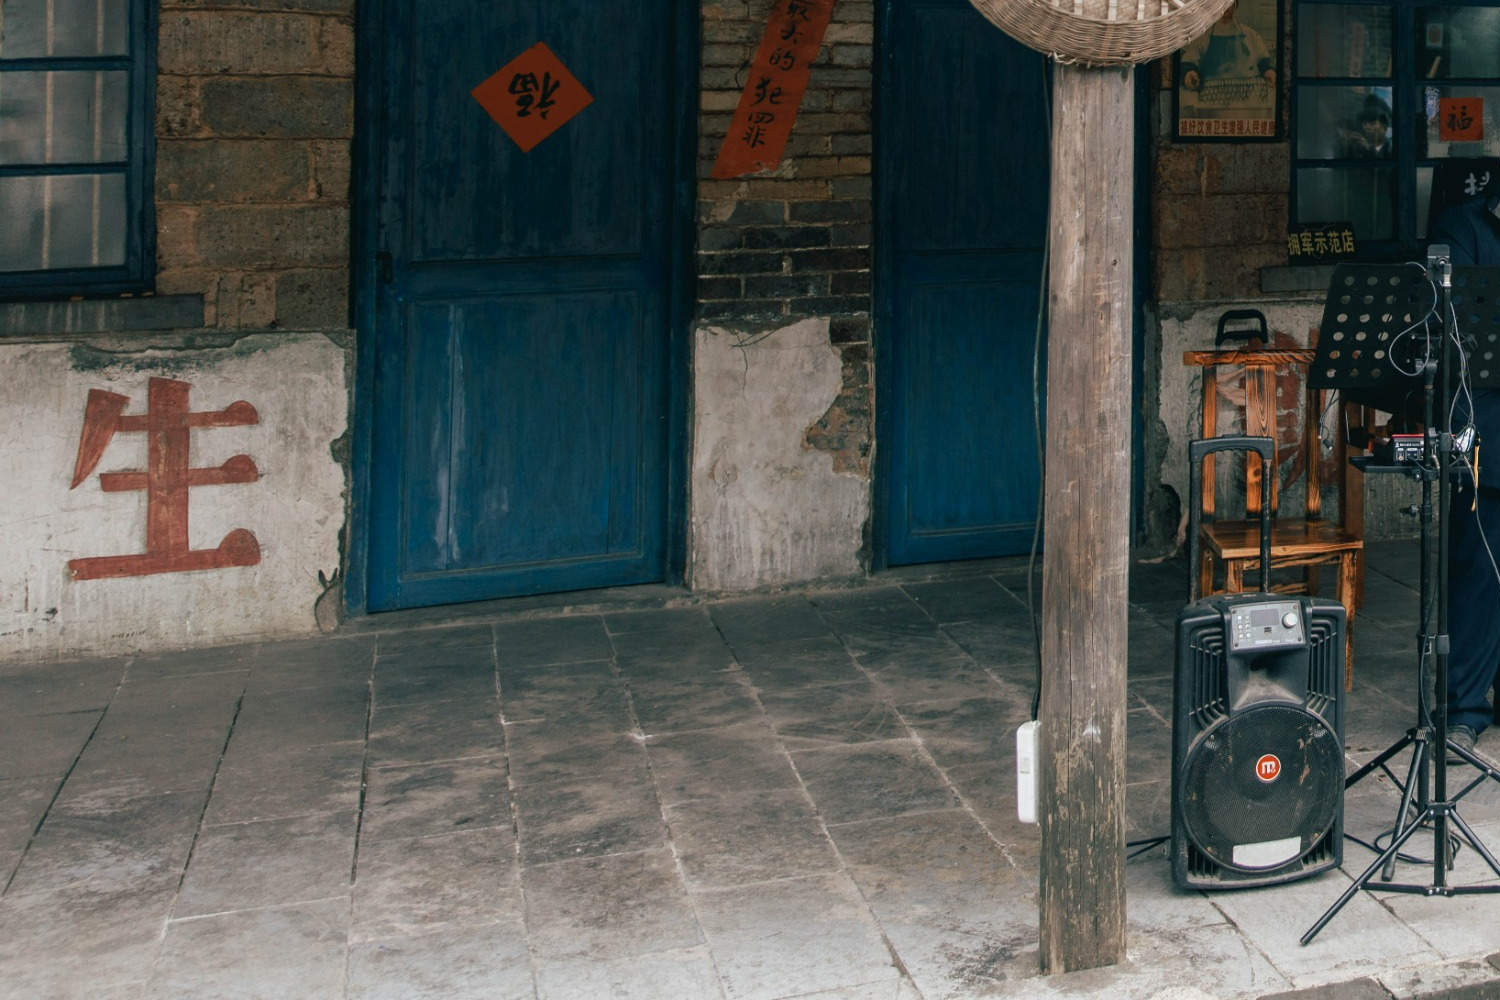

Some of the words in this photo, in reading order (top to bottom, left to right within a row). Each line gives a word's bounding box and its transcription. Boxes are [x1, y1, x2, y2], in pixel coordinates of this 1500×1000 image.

[508, 71, 560, 120] 福
[1446, 105, 1473, 132] 福
[1287, 229, 1355, 256] 拥军示范店
[67, 376, 262, 581] 生
